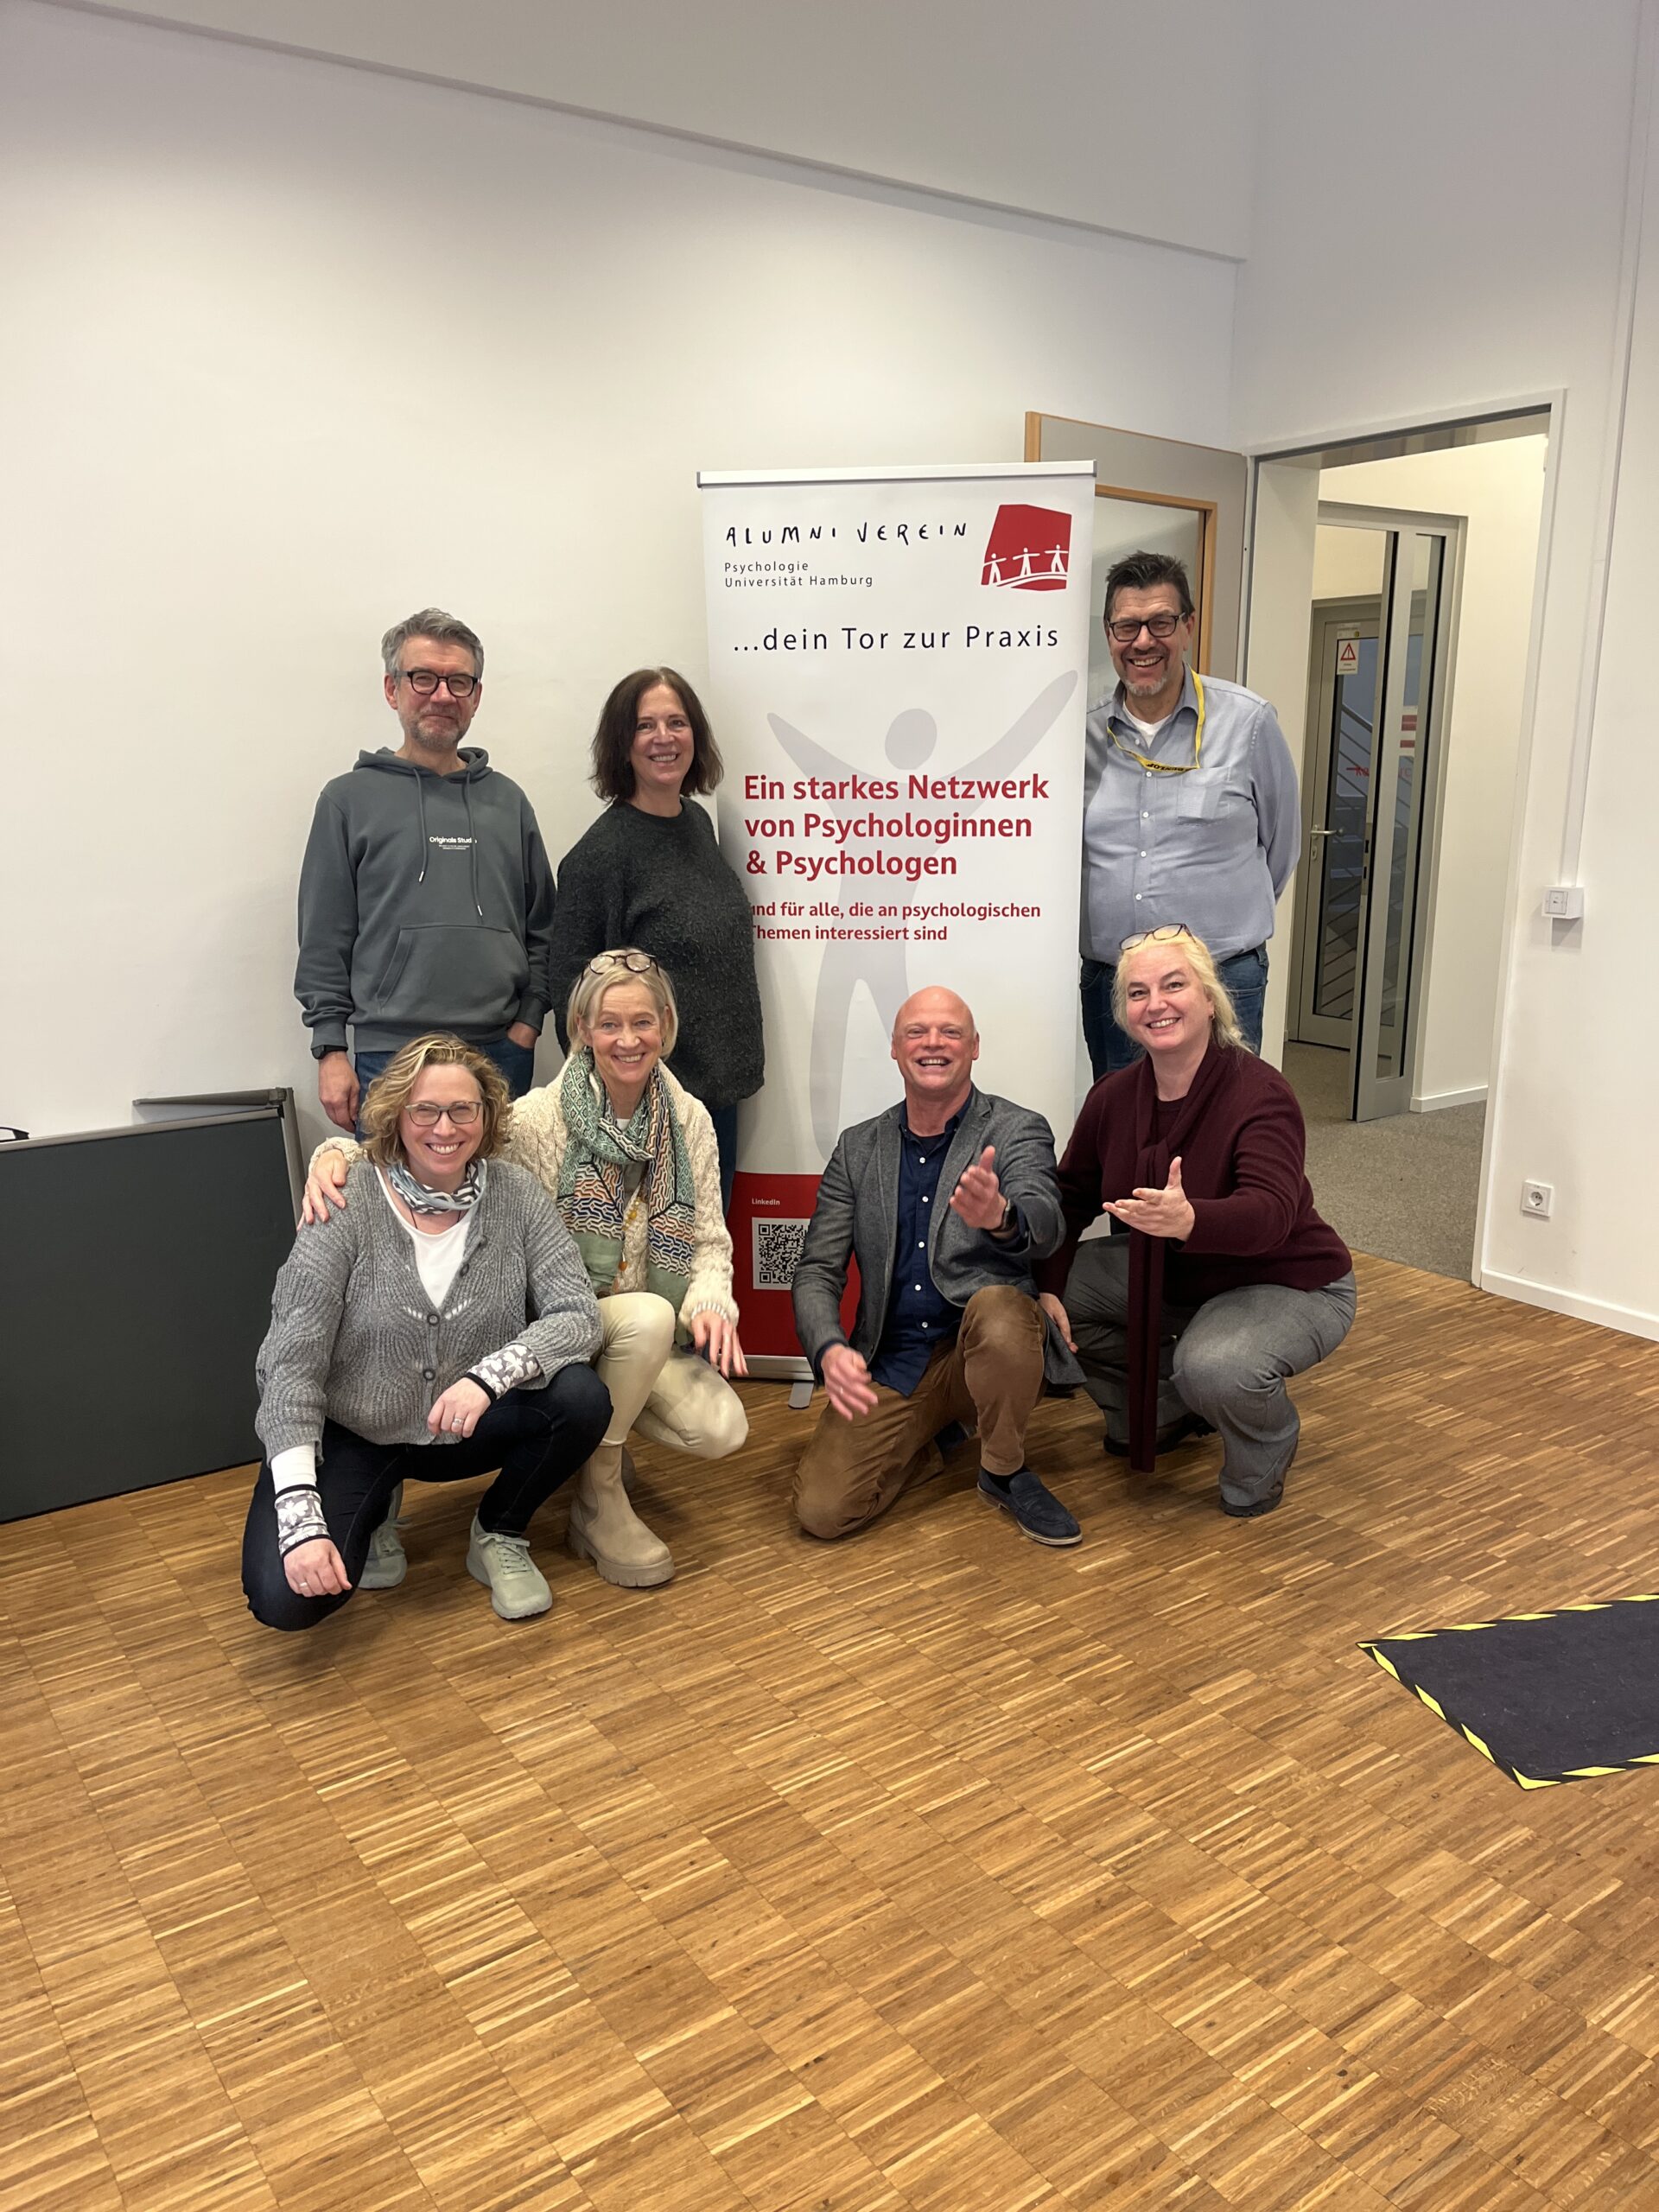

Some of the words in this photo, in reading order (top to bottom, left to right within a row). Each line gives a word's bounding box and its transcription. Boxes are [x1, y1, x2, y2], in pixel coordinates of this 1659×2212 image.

[726, 525, 836, 548] ALUMNI
[856, 522, 967, 546] VEREIN
[724, 561, 809, 574] Psychologie
[724, 575, 804, 588] Universität
[809, 574, 874, 588] Hamburg
[734, 627, 828, 652] ...dein
[841, 627, 889, 650] Tor
[903, 632, 950, 649] zur
[966, 624, 1058, 648] Praxis
[744, 774, 785, 800] Ein
[792, 774, 899, 800] starkes
[907, 773, 1050, 800] Netzwerk
[744, 818, 795, 838] von
[803, 812, 1033, 844] Psychologinnen
[746, 849, 767, 874] &
[776, 849, 957, 882] Psychologen
[780, 901, 804, 917] für
[809, 902, 845, 919] alle,
[849, 902, 874, 918] die
[877, 906, 898, 918] an
[901, 902, 1041, 921] psychologischen
[815, 925, 910, 941] interessiert
[913, 925, 948, 941] sind
